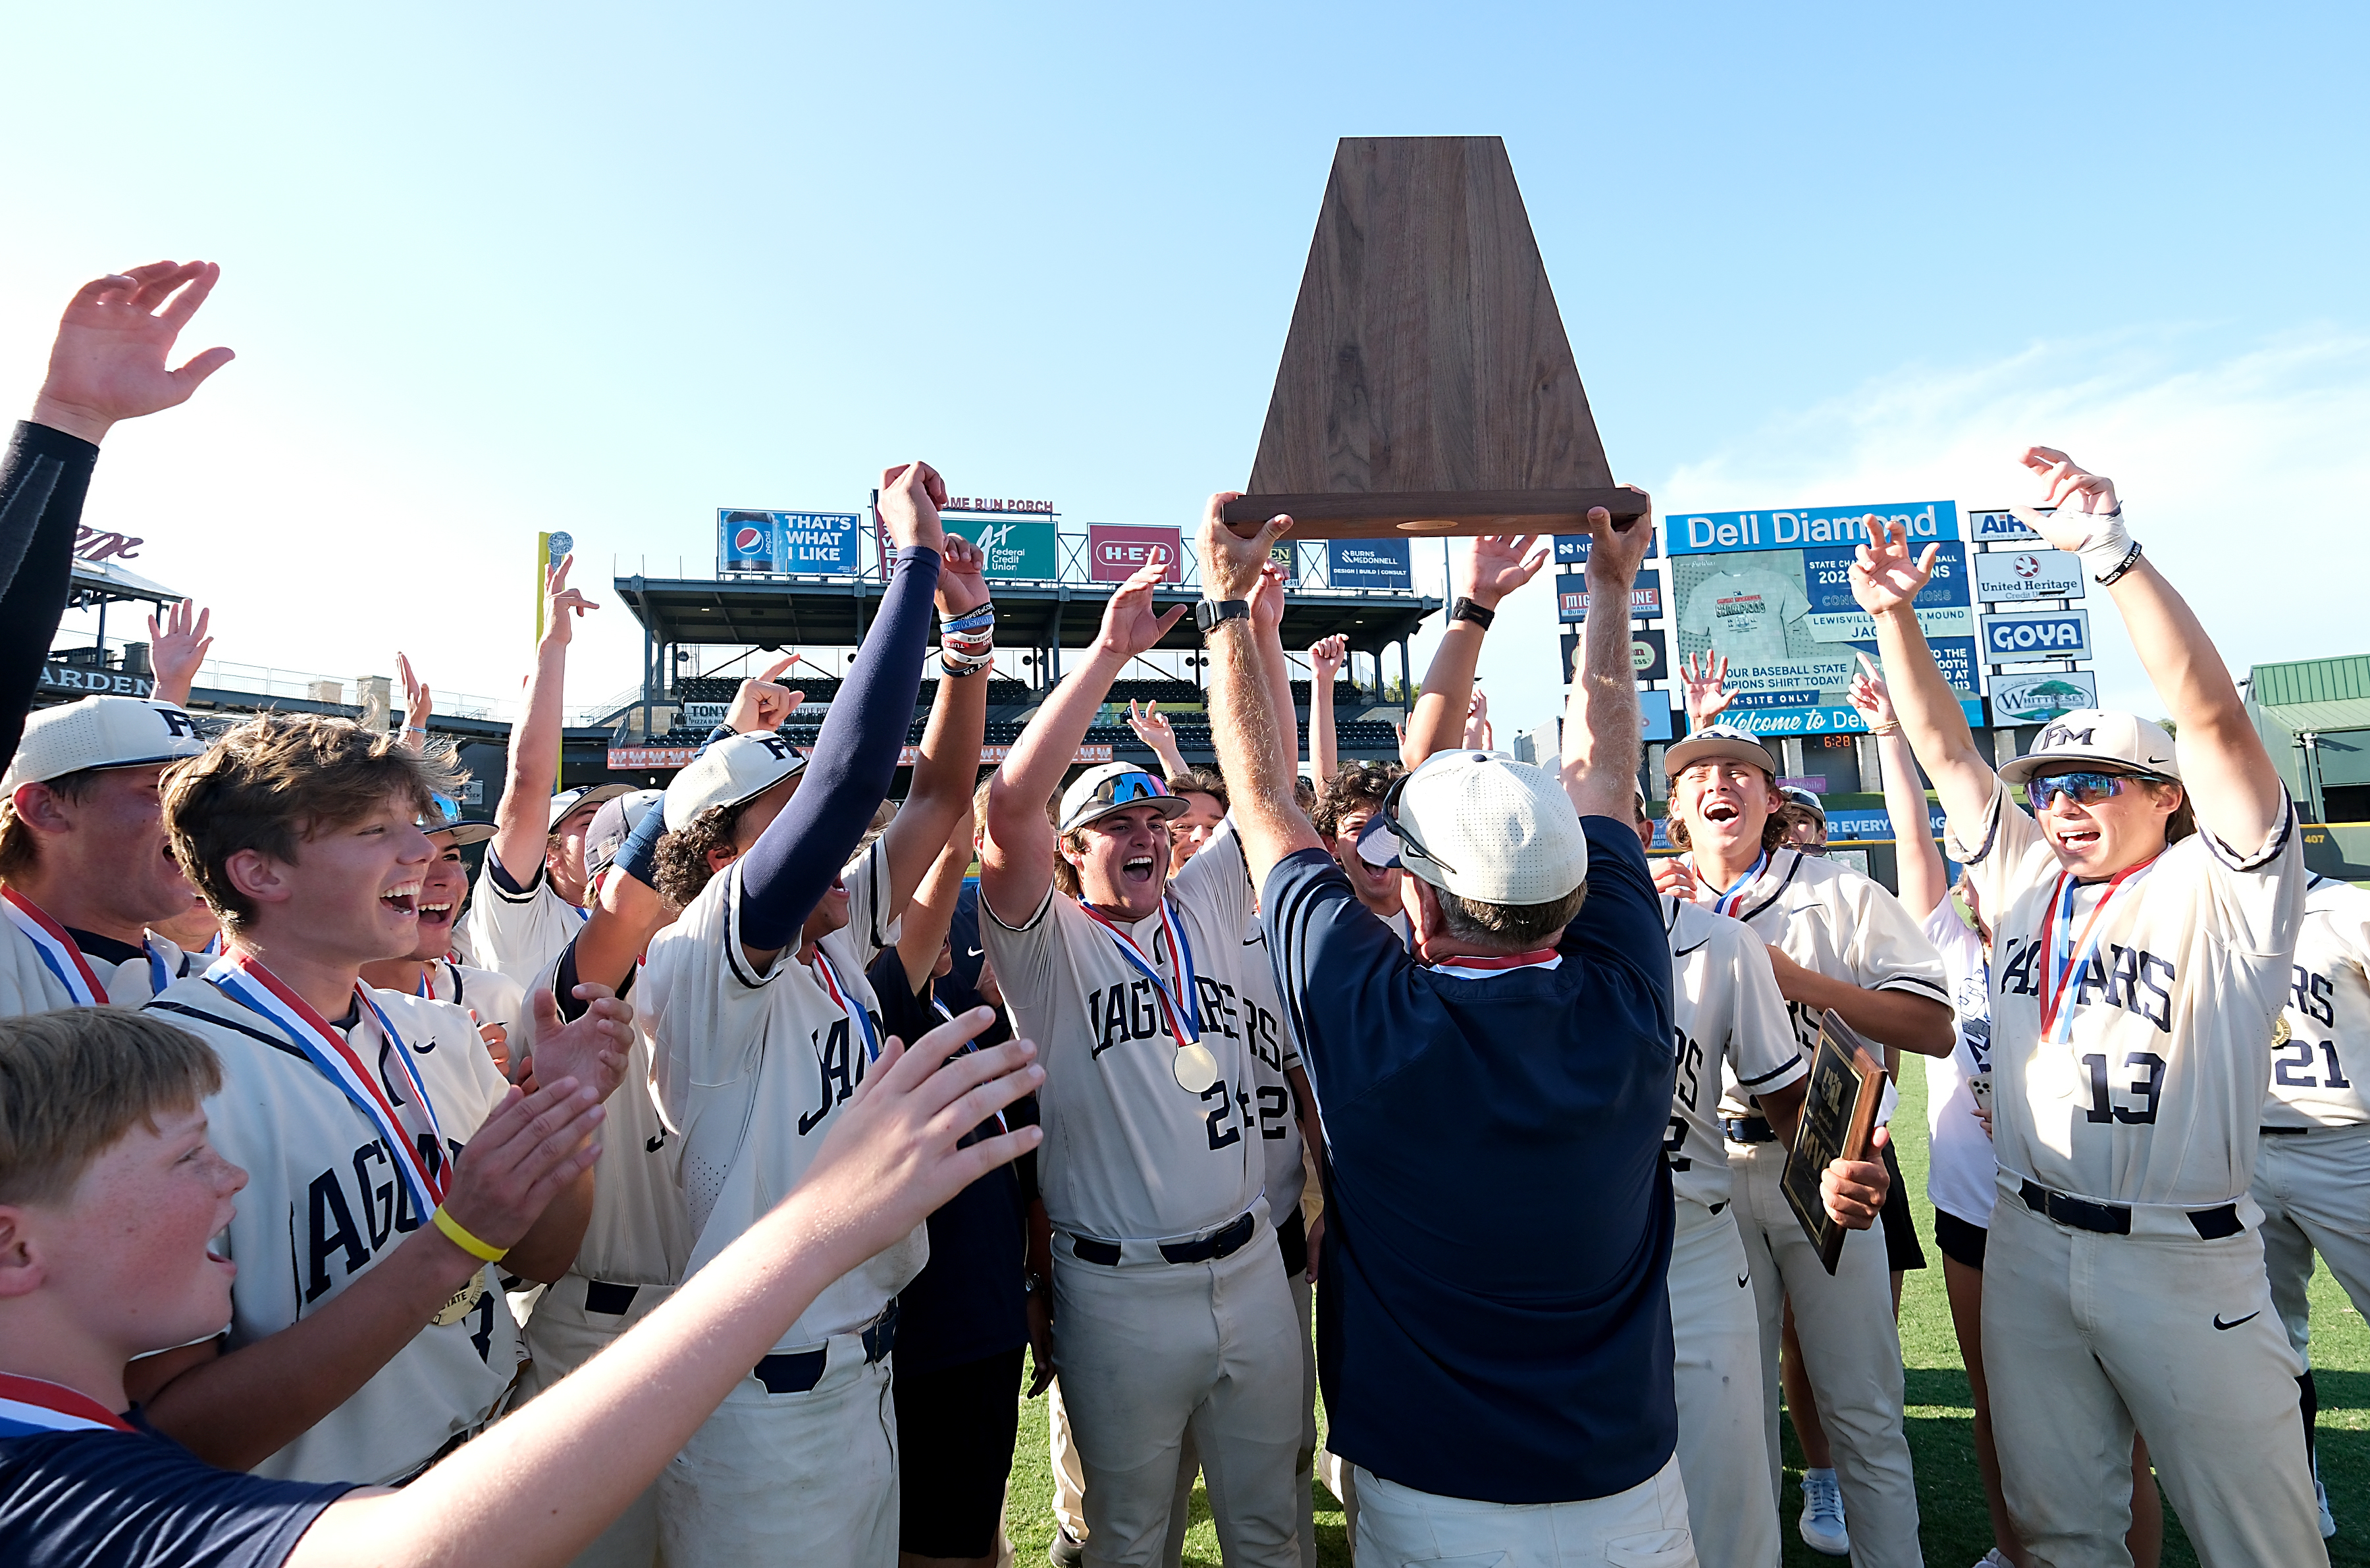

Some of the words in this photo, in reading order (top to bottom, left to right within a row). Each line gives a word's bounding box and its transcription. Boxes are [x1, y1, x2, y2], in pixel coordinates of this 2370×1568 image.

[975, 498, 1003, 511] RUN
[1008, 500, 1053, 513] PORCH
[786, 531, 842, 545] WHAT
[1688, 514, 1760, 548] Dell
[788, 547, 793, 559] I
[799, 547, 841, 561] LIKE
[992, 548, 1025, 556] Federal
[1809, 561, 1835, 569] STATE
[2123, 556, 2135, 568] DAY
[1982, 582, 2022, 592] United
[2024, 579, 2078, 590] Heritage
[1631, 591, 1654, 605] INE
[1715, 600, 1766, 618] CHAMPIONS
[1813, 615, 1874, 625] LEWISVILLE
[1927, 610, 1964, 620] MOUND
[1993, 623, 2078, 650] GOYA
[1944, 648, 1967, 658] THE
[1726, 668, 1749, 678] OUR
[1752, 666, 1809, 677] BASEBALL
[1813, 664, 1847, 673] STATE
[1937, 659, 1968, 669] OOTH
[40, 666, 155, 696] ARDEN
[1955, 669, 1969, 679] AT
[1722, 679, 1764, 690] MPIONS
[1768, 677, 1799, 687] SHIRT
[1804, 676, 1844, 686] TODAY!
[1953, 681, 1970, 691] 113
[1731, 695, 1774, 705] N-SITE
[1779, 694, 1810, 703] ONLY
[1715, 711, 1803, 733] Welcome
[1805, 708, 1826, 731] to
[2041, 724, 2096, 750] FM
[1841, 819, 1889, 833] EVERY
[2304, 835, 2325, 843] 407
[2275, 1039, 2350, 1088] 21
[2082, 1052, 2167, 1124] 13
